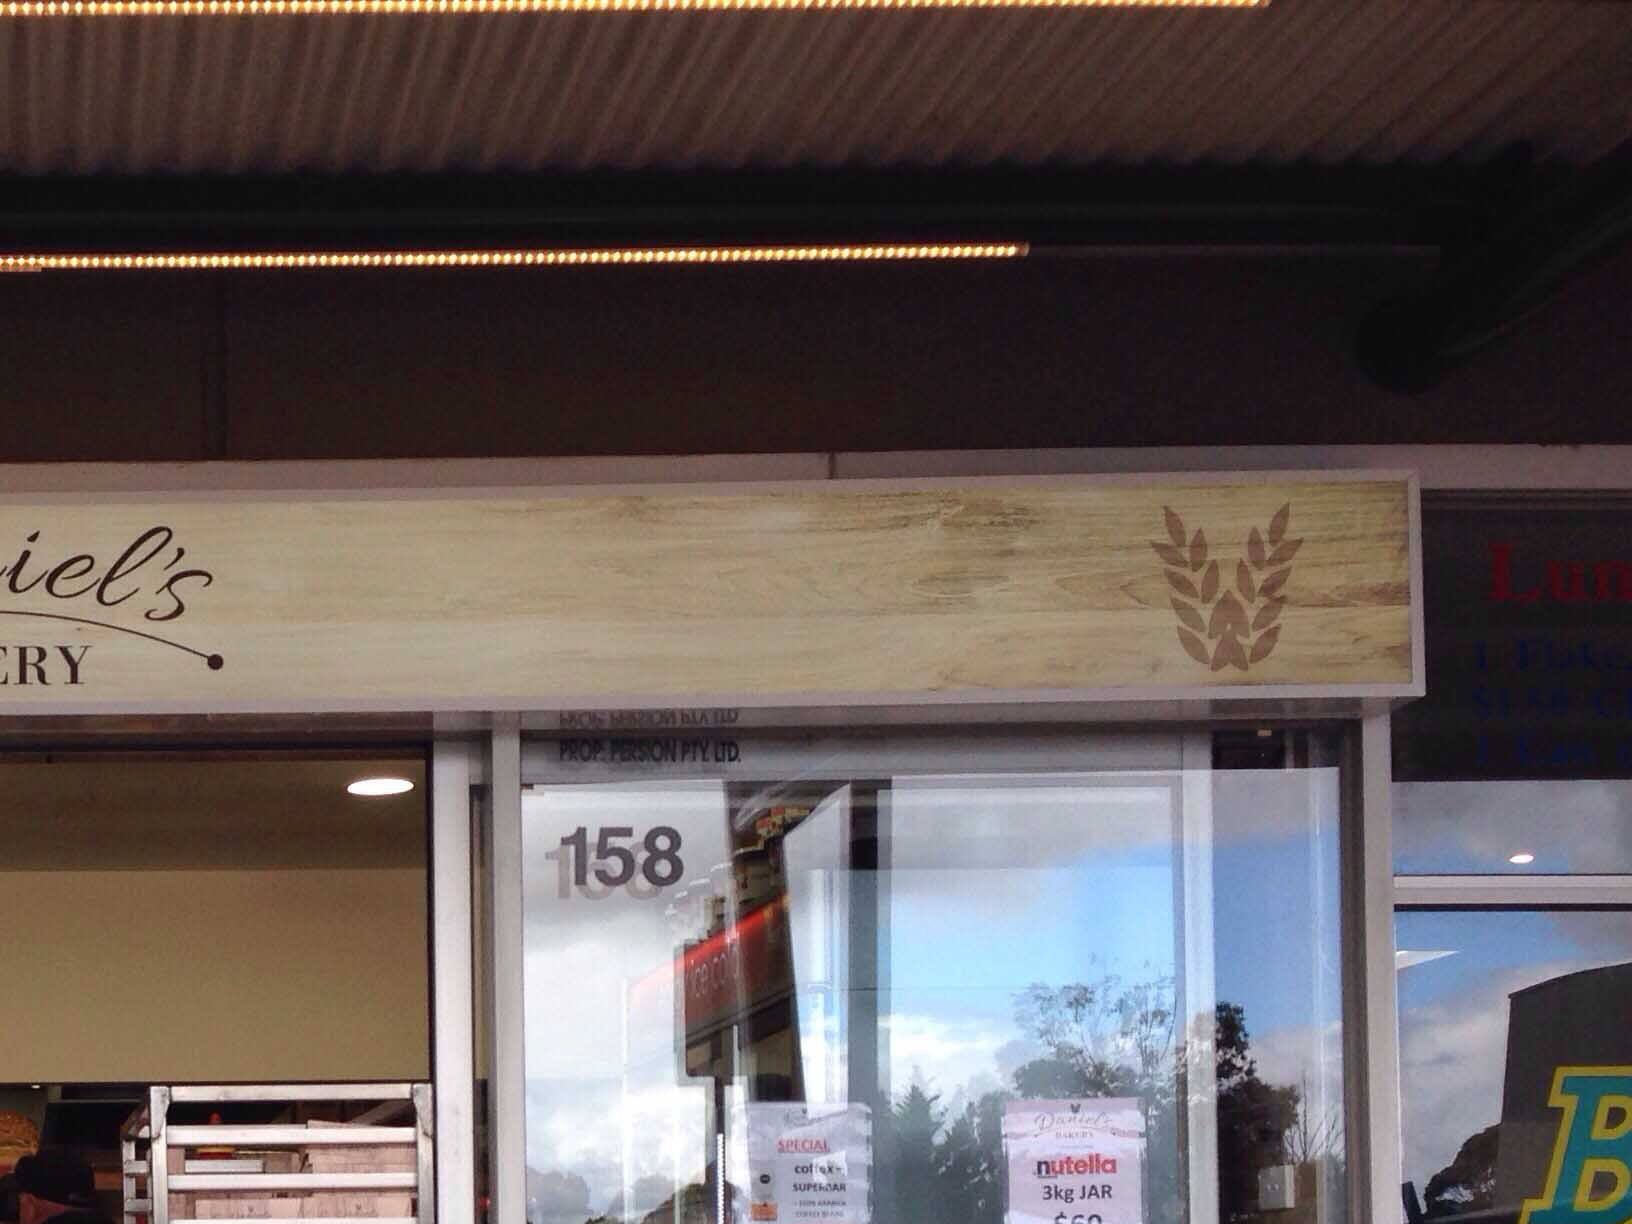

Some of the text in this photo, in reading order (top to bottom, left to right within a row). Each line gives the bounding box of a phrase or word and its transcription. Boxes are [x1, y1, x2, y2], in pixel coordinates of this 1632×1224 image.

[561, 826, 684, 886] 158
[778, 1138, 830, 1152] SPECIAL
[1036, 1153, 1117, 1176] nutella
[1043, 1184, 1112, 1203] 3kg JAR
